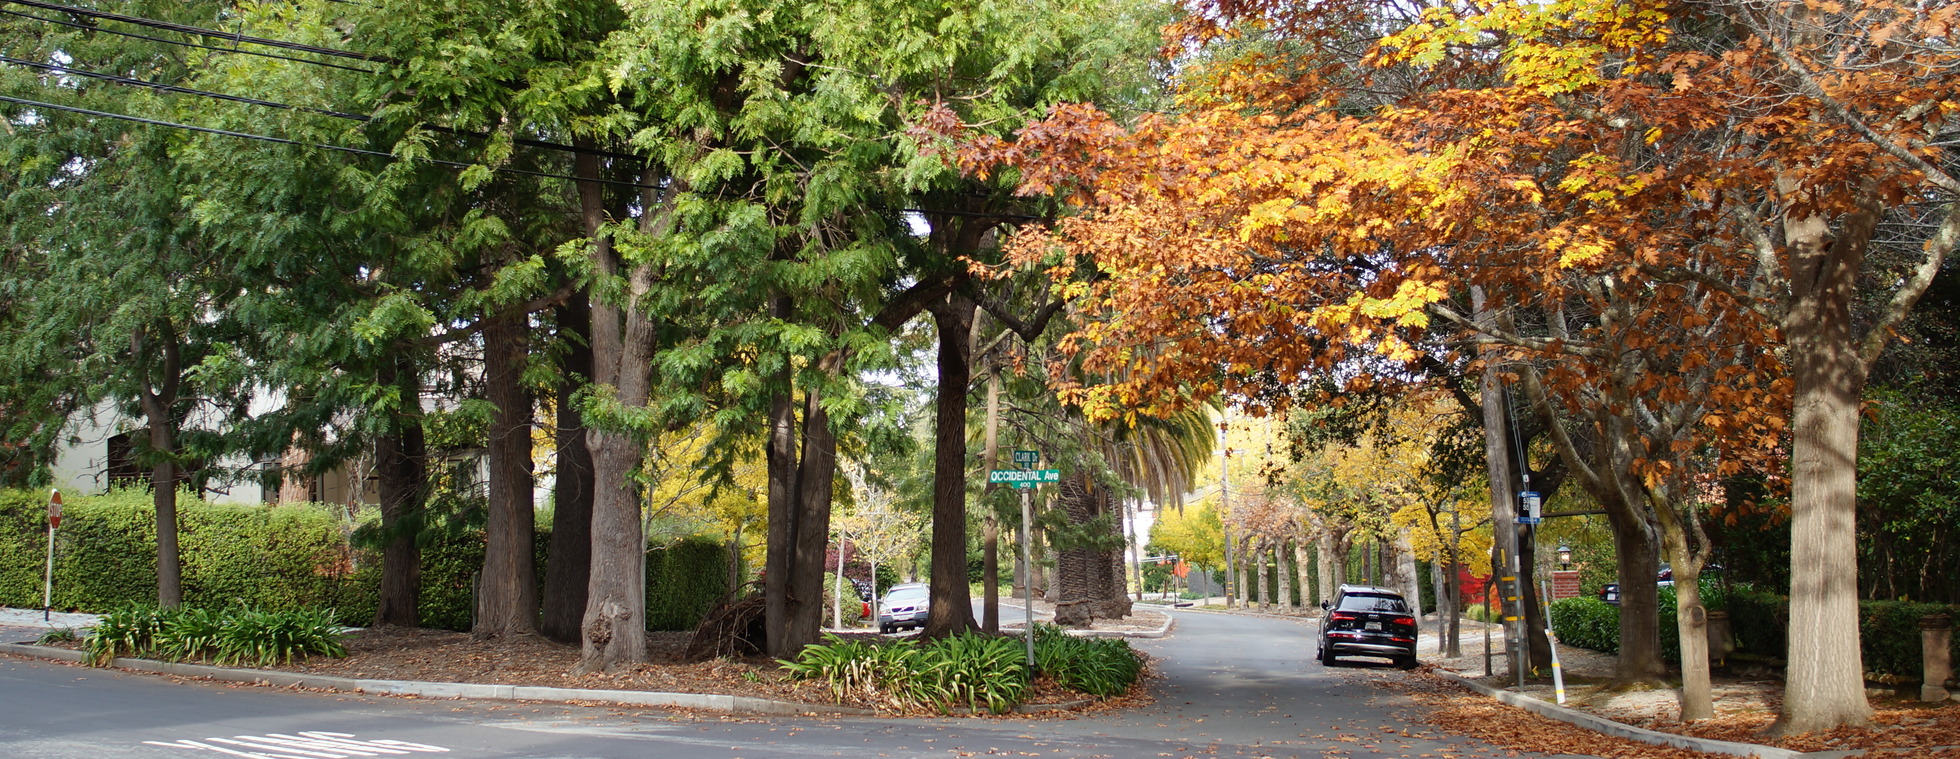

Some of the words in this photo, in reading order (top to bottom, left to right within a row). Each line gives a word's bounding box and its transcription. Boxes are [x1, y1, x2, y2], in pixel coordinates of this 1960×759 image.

[1015, 452, 1031, 462] CLARK
[1032, 452, 1038, 462] Dr
[991, 471, 1041, 481] OCCIDENTAL
[1044, 470, 1059, 481] Ave
[50, 503, 62, 517] STOP
